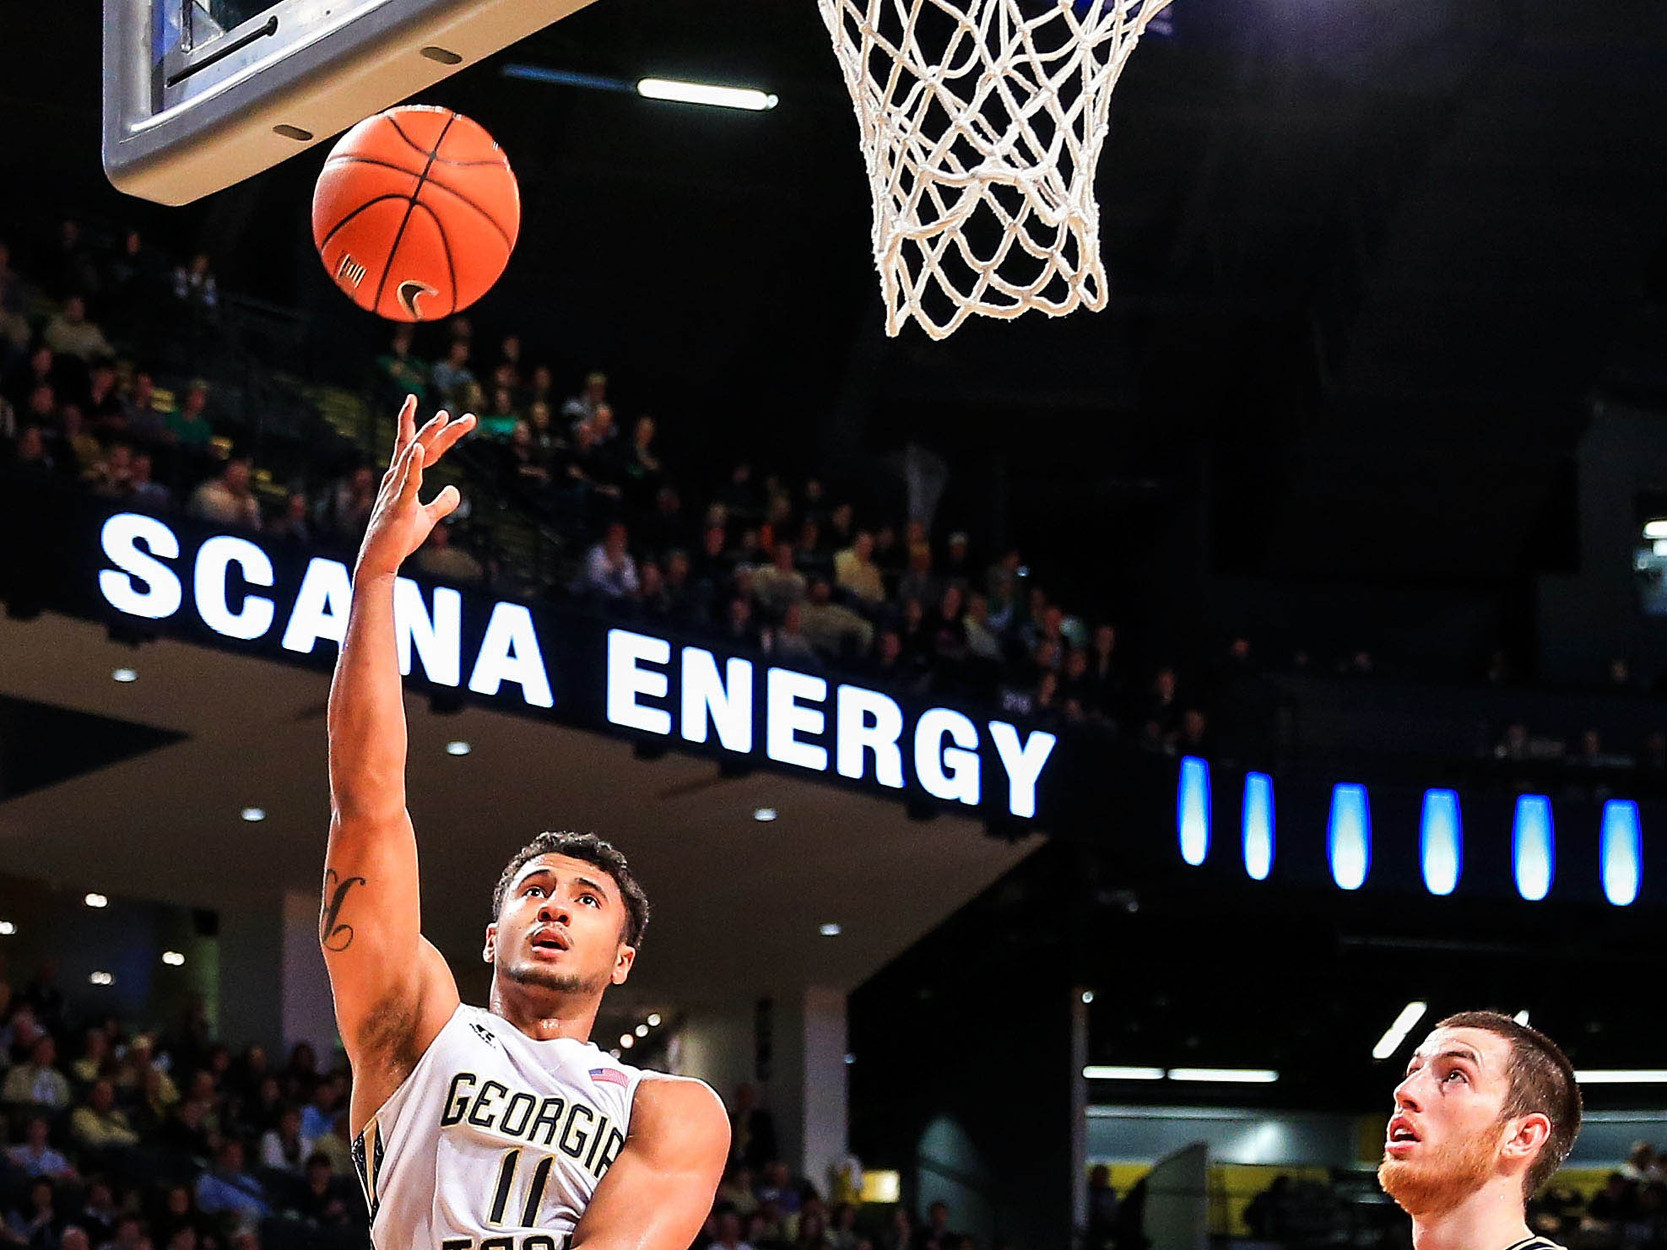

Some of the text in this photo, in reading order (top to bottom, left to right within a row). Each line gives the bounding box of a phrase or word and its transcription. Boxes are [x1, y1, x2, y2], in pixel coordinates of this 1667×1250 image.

[99, 512, 1057, 819] SCANA ENERGY
[440, 1072, 625, 1178] GEORGIA
[488, 1148, 555, 1228] 11
